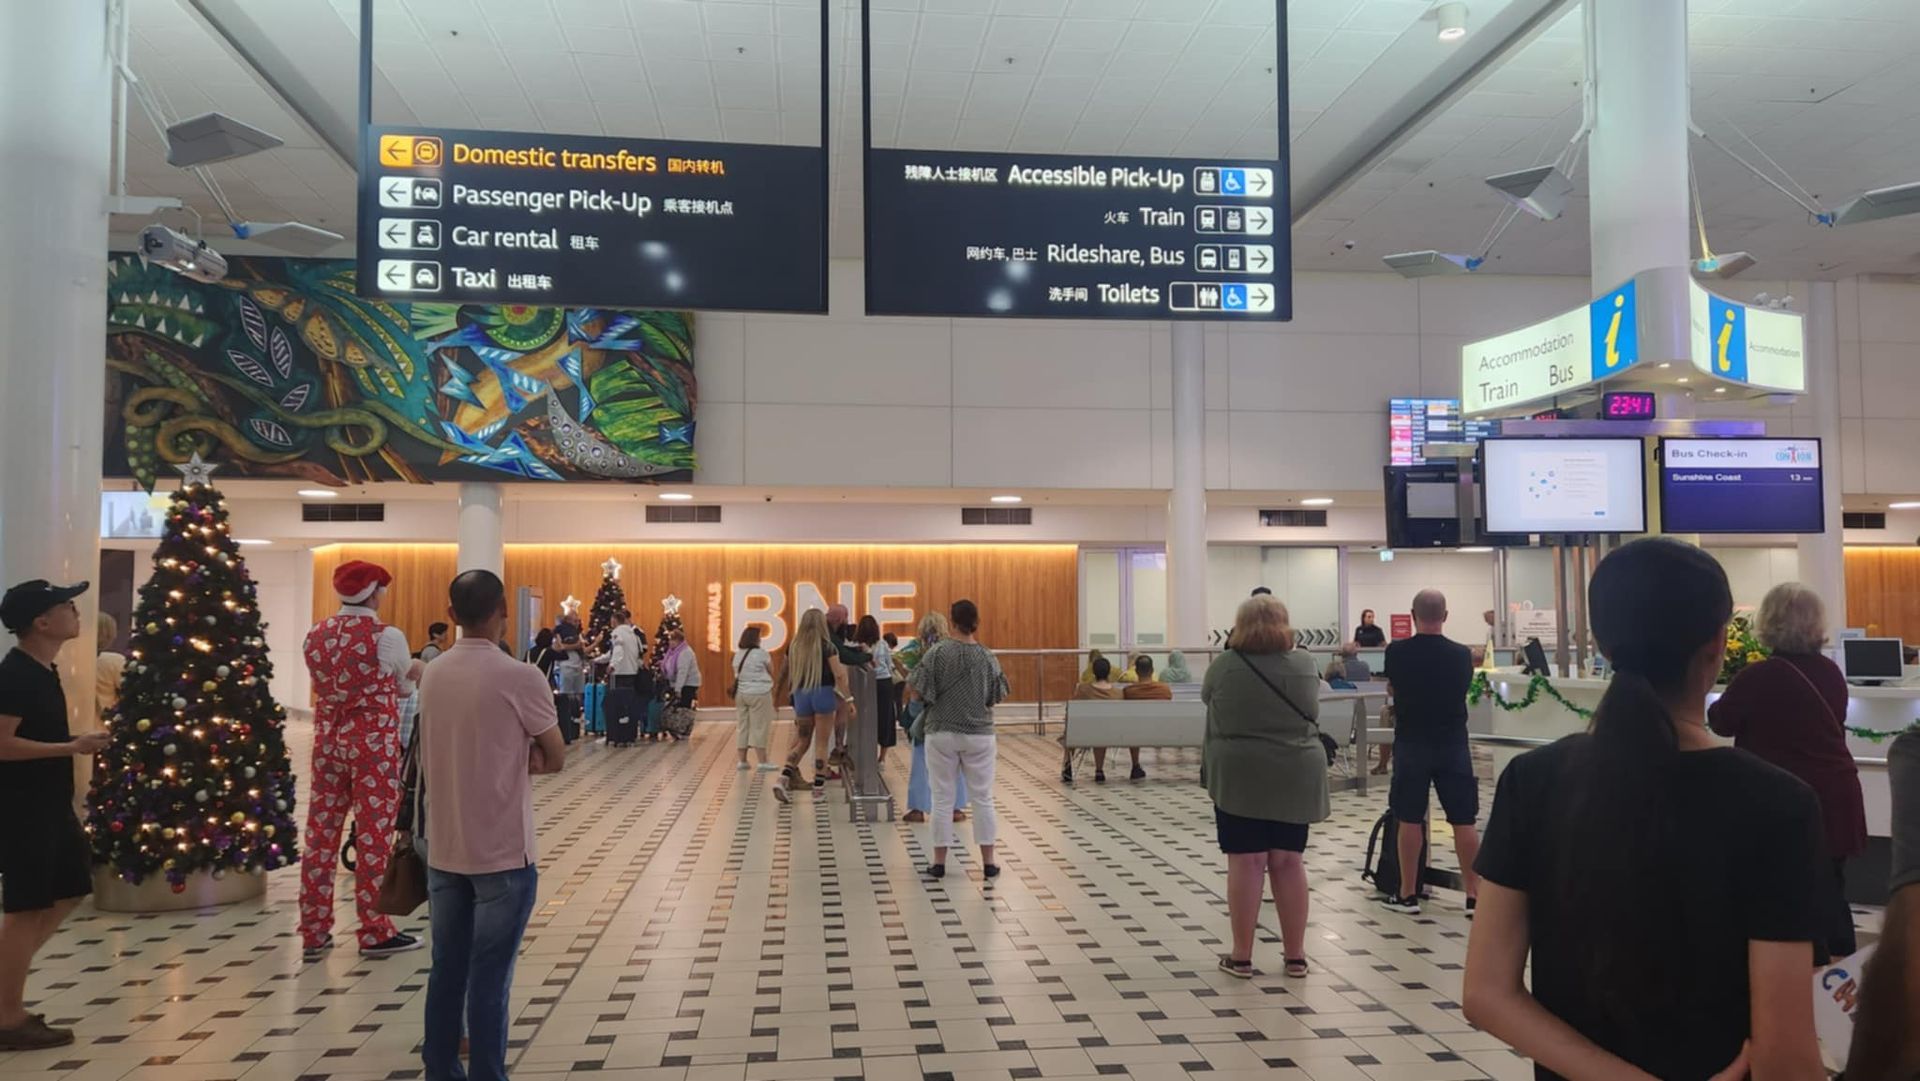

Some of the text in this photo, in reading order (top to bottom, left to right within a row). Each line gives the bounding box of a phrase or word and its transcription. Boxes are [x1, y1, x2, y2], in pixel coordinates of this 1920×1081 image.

[453, 143, 657, 172] Domestic transfers
[667, 157, 725, 175] 国内转机
[904, 165, 998, 183] 残障人士接机区
[1008, 165, 1185, 193] Accessible Pick-Up
[452, 184, 652, 217] Passenger Pick-Up
[663, 198, 734, 215] 乘客接机点
[1104, 210, 1130, 225] 火车
[1139, 207, 1185, 226] Train
[452, 226, 559, 250] Car rental
[570, 235, 600, 250] 租车
[1048, 244, 1185, 267] Rideshare, Bus
[451, 267, 497, 289] Taxi
[507, 274, 552, 290] 出租车
[1048, 286, 1088, 302] 洗手间
[1097, 282, 1160, 304] Toilets
[1478, 332, 1574, 372] Accommodation
[1478, 364, 1574, 403] Train Bus
[1610, 396, 1651, 415] 23:41
[1671, 448, 1748, 458] Bus Check-in
[1672, 473, 1742, 482] Sunshine Coast
[706, 581, 722, 652] ARRIVALS
[731, 582, 916, 652] BNE
